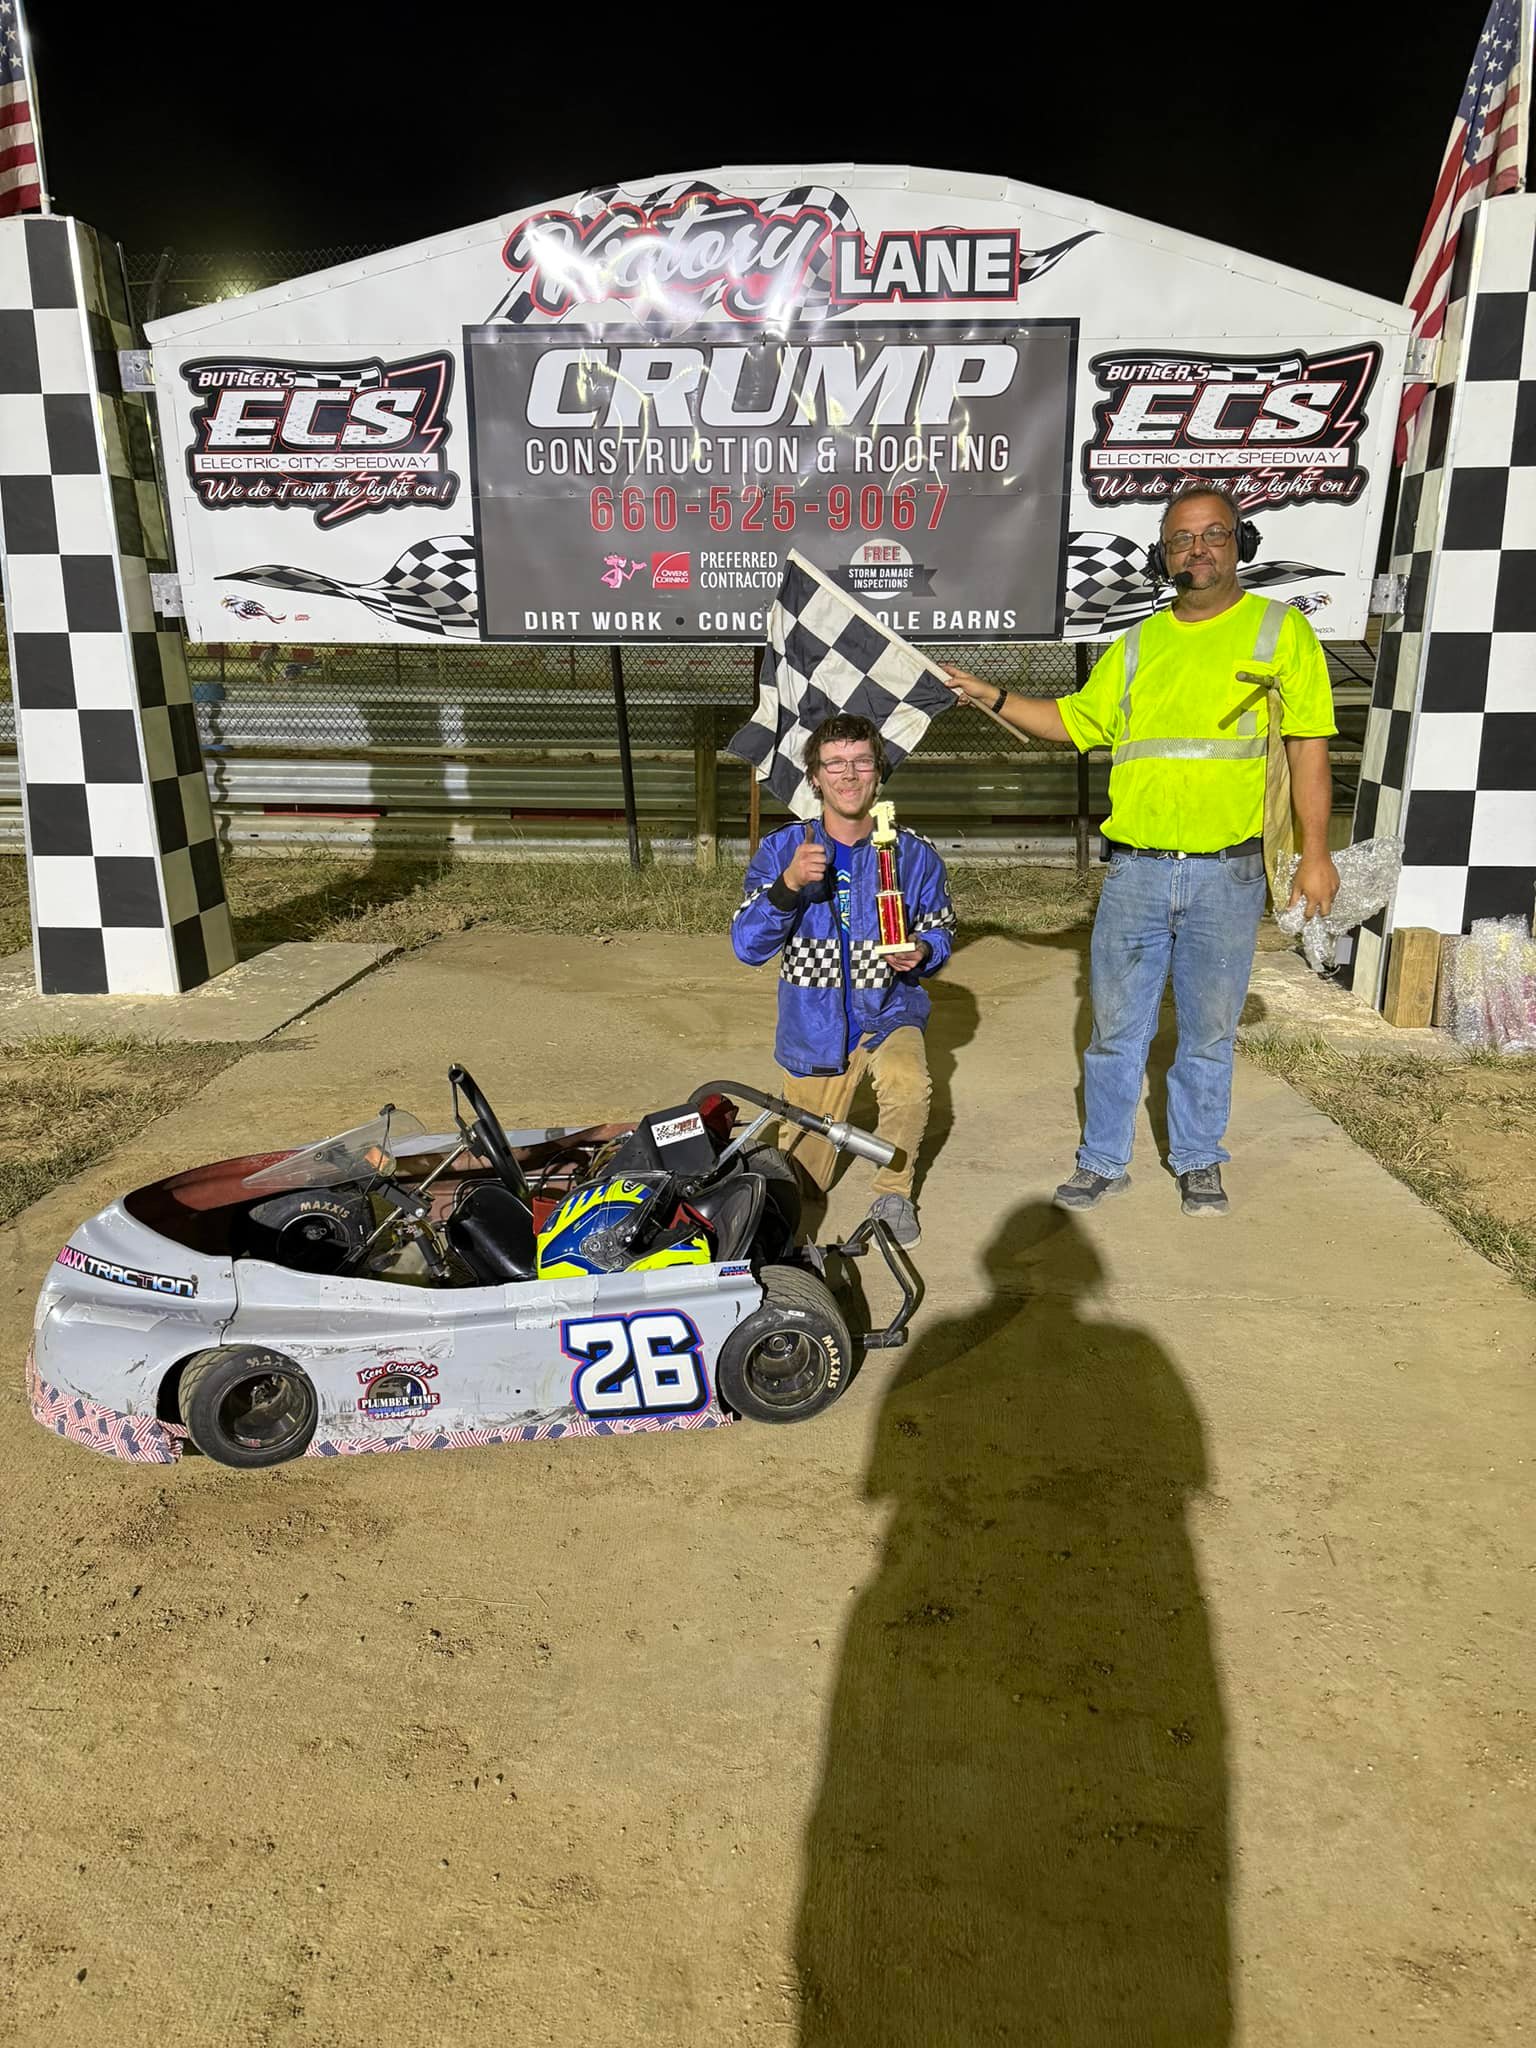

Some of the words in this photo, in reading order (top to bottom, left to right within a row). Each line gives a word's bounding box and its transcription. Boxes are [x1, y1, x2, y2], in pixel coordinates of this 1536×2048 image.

[838, 238, 1012, 294] LANE
[198, 371, 296, 387] BUTLER'S
[1106, 363, 1212, 381] BUTLER'S
[527, 345, 1017, 427] CRUMP
[206, 389, 422, 447] ECS
[1106, 383, 1344, 441] ECS
[201, 457, 280, 469] ELECTRIC
[334, 456, 431, 468] SPEEDWAY
[525, 437, 799, 475] CONSTRUCTION
[817, 438, 836, 473] &
[854, 434, 1009, 474] ROOFING
[1097, 453, 1179, 465] ELECTRIC
[1238, 452, 1341, 464] SPEEDWAY
[201, 479, 243, 500] We
[248, 480, 272, 497] do
[276, 482, 291, 499] it
[294, 481, 330, 500] with
[332, 480, 361, 499] the
[365, 478, 408, 504] lights
[1094, 475, 1137, 497] We
[1142, 476, 1167, 494] do
[1232, 476, 1262, 496] the
[1267, 476, 1312, 500] lights
[590, 484, 951, 533] 660-525-9067
[700, 551, 777, 569] PREFERRED
[863, 545, 901, 561] FREE
[700, 571, 784, 588] CONTRACTOR
[848, 568, 877, 579] STORM
[879, 567, 914, 578] DAMAGE
[854, 578, 908, 589] INSPECTIONS
[524, 611, 580, 630] DIRT
[591, 611, 662, 631] WORK
[876, 611, 920, 630] OLE
[932, 610, 1017, 630] BARNS
[300, 1200, 350, 1218] MAXXIS
[566, 1315, 700, 1411] 26
[821, 1334, 841, 1389] MAXXIS
[360, 1368, 383, 1383] Ken
[386, 1362, 437, 1377] Crosby's
[361, 1397, 410, 1409] PLUMBER
[411, 1394, 438, 1405] TIME
